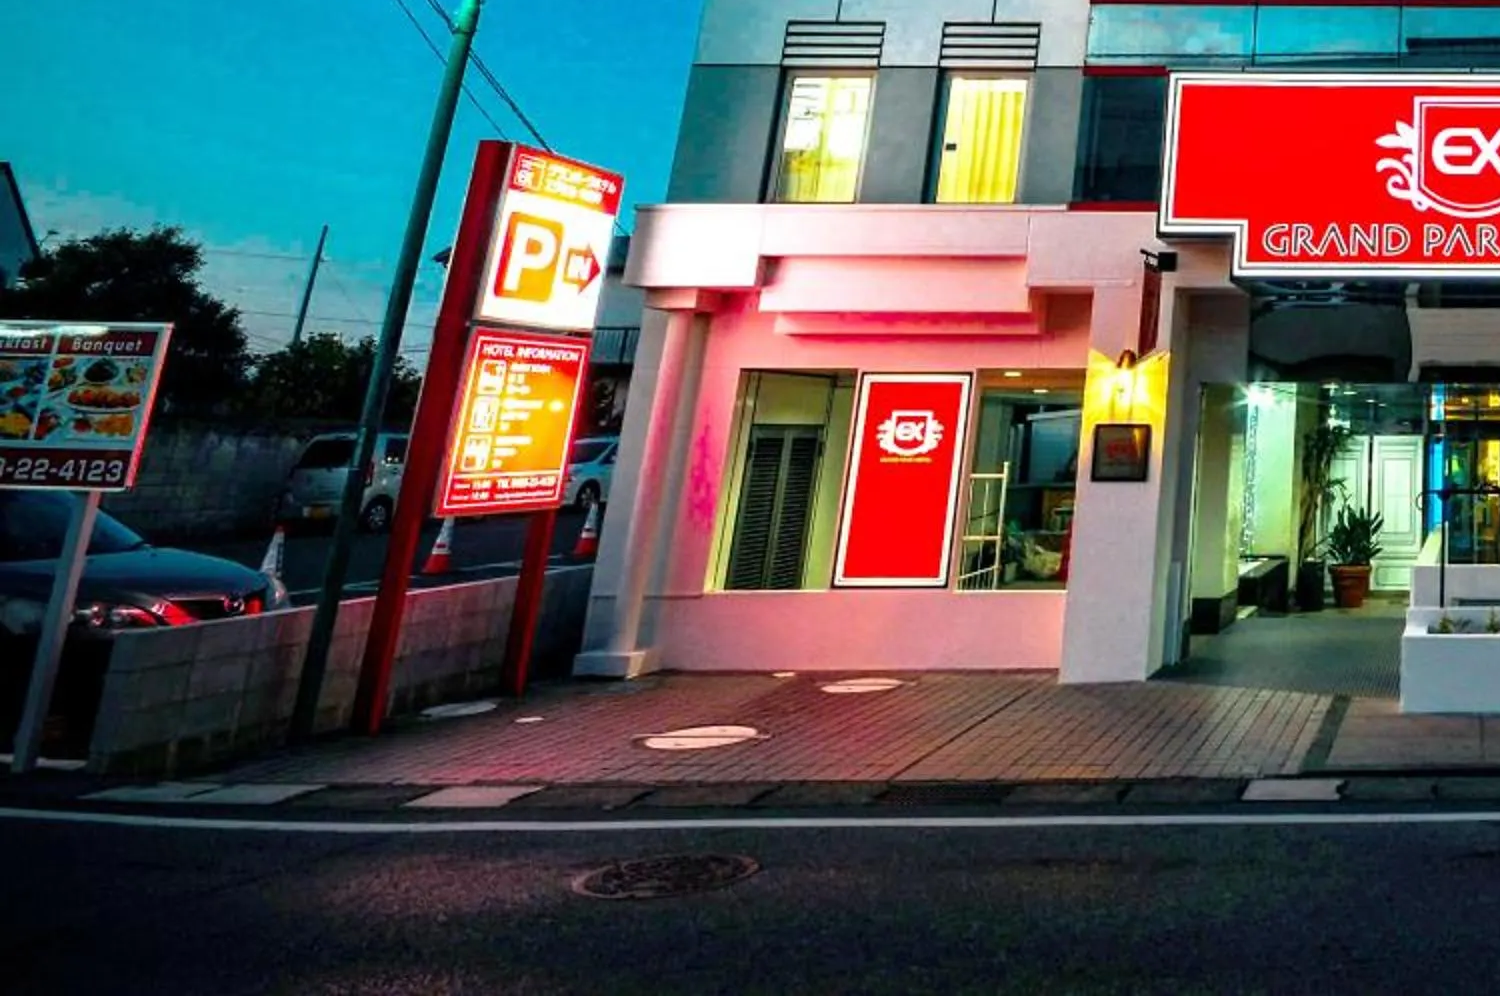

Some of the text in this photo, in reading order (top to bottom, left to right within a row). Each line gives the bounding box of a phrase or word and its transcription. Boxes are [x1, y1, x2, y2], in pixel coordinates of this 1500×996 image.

[1262, 223, 1411, 257] GRAND
[502, 221, 557, 292] P
[71, 336, 143, 354] Banquet
[482, 344, 580, 362] HOTEL INFORMATION
